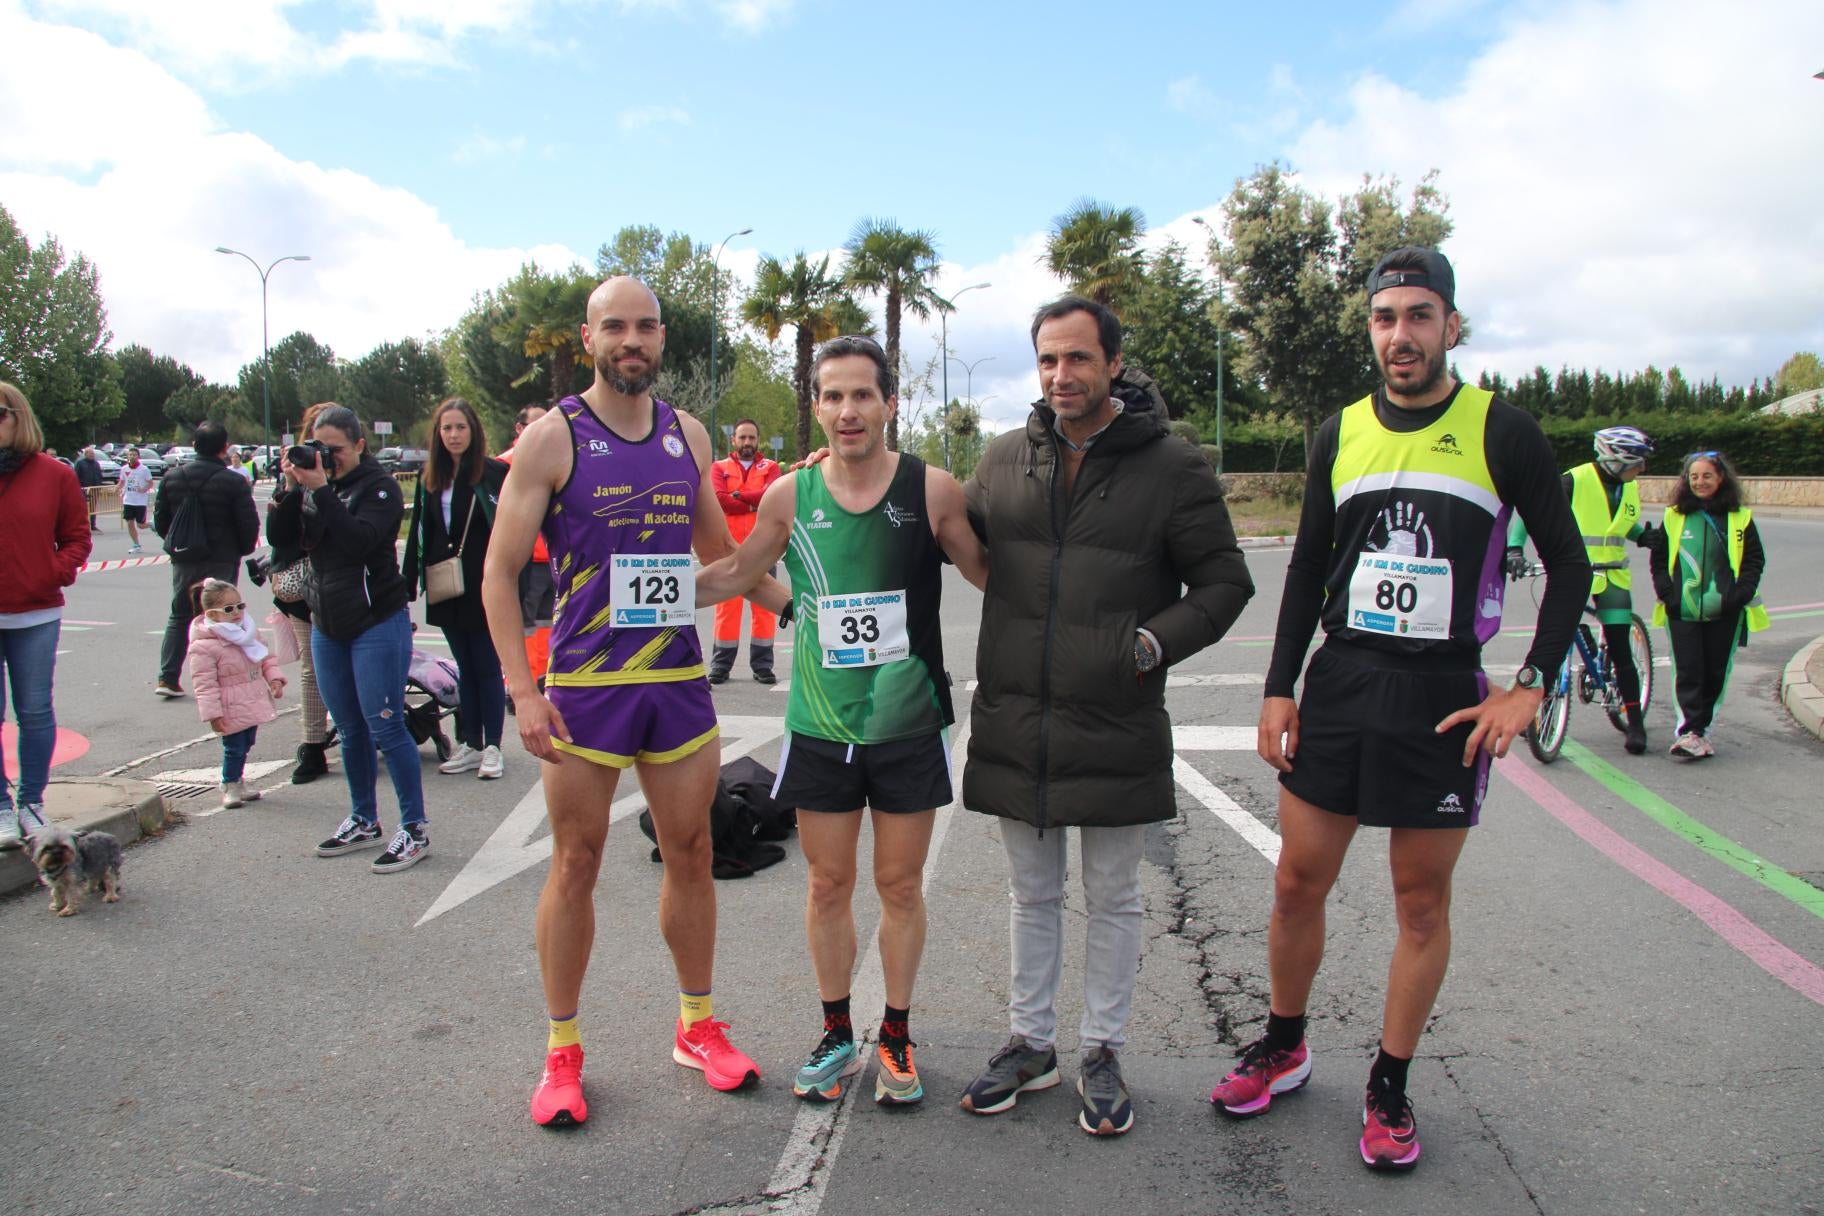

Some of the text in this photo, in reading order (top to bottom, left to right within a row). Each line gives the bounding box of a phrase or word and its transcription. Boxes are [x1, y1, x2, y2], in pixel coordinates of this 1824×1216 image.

[593, 483, 632, 498] Jamón
[653, 494, 686, 506] PRIM
[644, 512, 690, 525] Macotera
[616, 558, 629, 568] 10
[631, 558, 645, 568] KM
[647, 558, 659, 568] DE
[1362, 558, 1373, 567] 10
[1374, 559, 1389, 569] KM
[1391, 561, 1405, 571] DE
[1383, 572, 1417, 581] VILLAMAYOR
[629, 576, 680, 604] 123
[1375, 579, 1418, 613] 80
[821, 600, 831, 609] 10
[832, 599, 847, 609] KM
[849, 597, 862, 607] DE
[840, 615, 880, 645] 33
[1410, 625, 1445, 633] VILLAMAYOR
[878, 648, 906, 657] VILLAMAYOR
